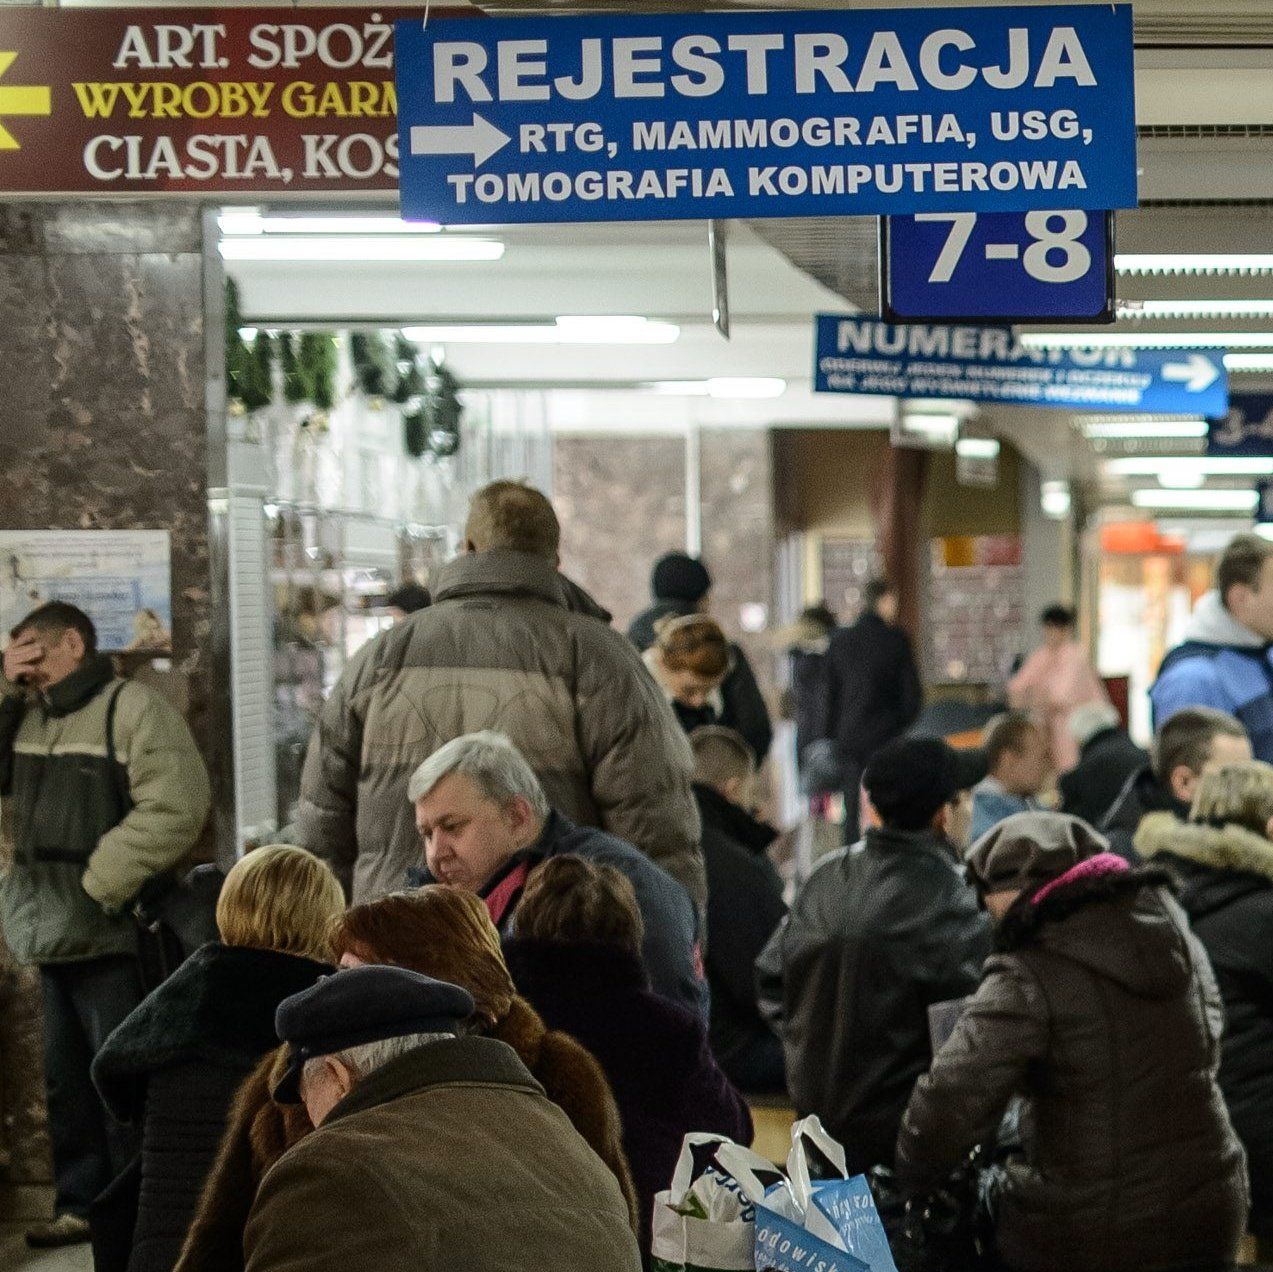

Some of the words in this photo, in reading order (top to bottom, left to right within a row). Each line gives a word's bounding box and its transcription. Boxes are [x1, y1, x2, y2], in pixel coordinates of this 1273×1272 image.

[113, 24, 229, 69] ART.
[433, 26, 1098, 104] REJESTRACJA
[72, 81, 275, 119] WYROBY
[83, 134, 294, 184] CIASTA,
[519, 121, 618, 159] RTG,
[632, 113, 977, 151] MAMMOGRAFIA,
[990, 109, 1093, 145] USG,
[446, 166, 735, 204] TOMOGRAFIA
[748, 160, 1087, 196] KOMPUTEROWA
[914, 209, 1091, 283] 7-8
